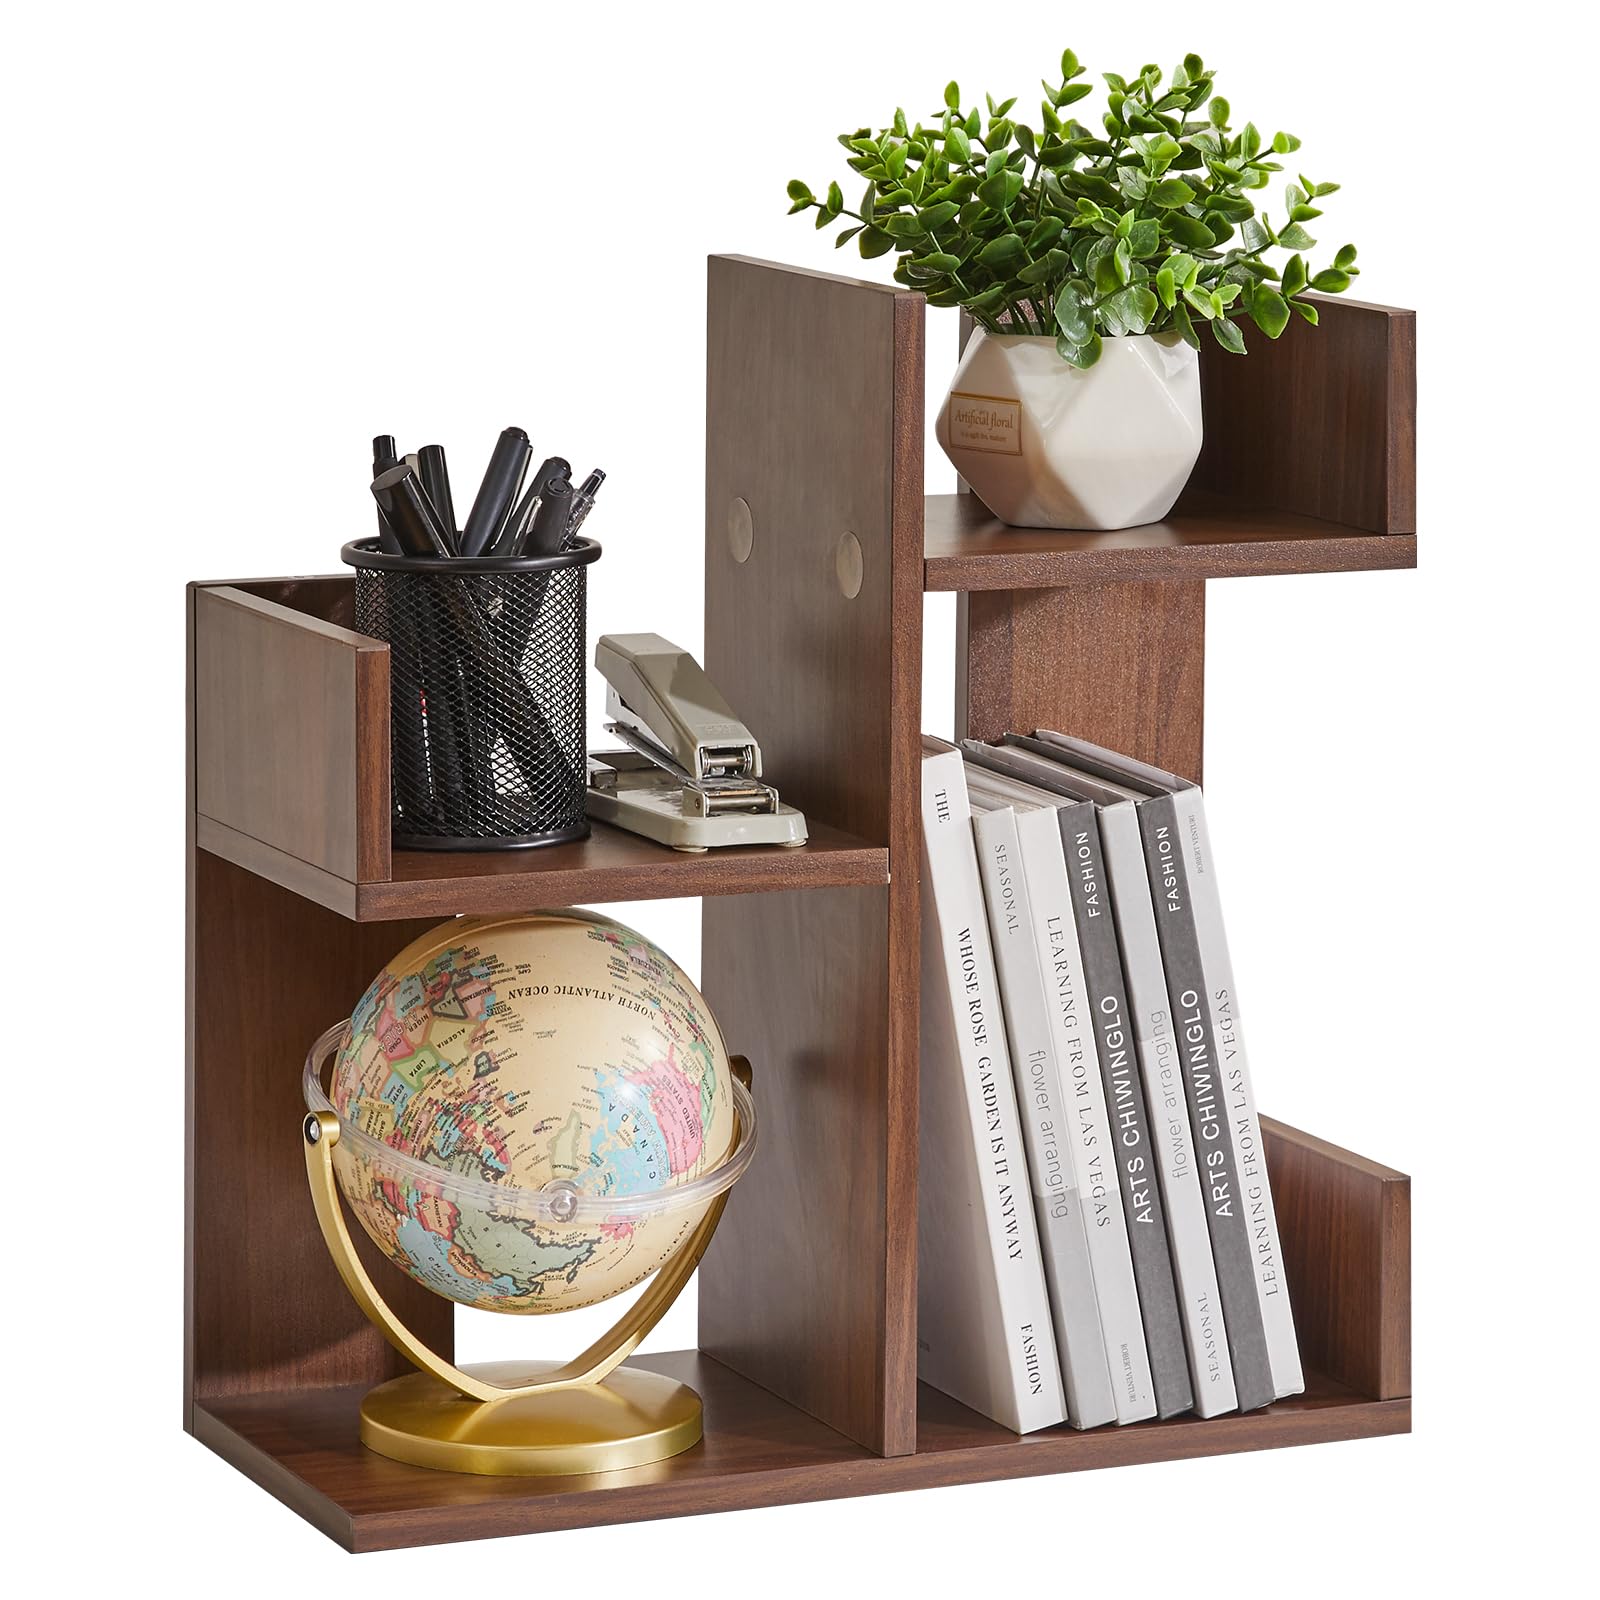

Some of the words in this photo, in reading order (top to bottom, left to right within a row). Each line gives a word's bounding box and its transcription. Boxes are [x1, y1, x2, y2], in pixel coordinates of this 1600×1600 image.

[955, 409, 989, 428] Artificial
[988, 411, 1013, 430] floral
[933, 788, 952, 824] THE
[1075, 831, 1100, 918] FASHION
[1156, 826, 1181, 912] FASHION
[994, 843, 1022, 935] SEASONAL
[629, 955, 662, 977] VENEZUELA
[956, 927, 982, 994] WHOSE
[400, 994, 421, 1013] NIGERIA
[460, 986, 492, 1003] MAURITANIA
[508, 986, 549, 999] OCEAN
[553, 984, 615, 1001] ATLANTIC
[657, 991, 681, 1011] CARIBBEAN
[407, 1014, 429, 1032] NIGER
[618, 997, 656, 1020] NORTH
[969, 993, 989, 1047] ROSE
[436, 1028, 466, 1049] ALGERIA
[471, 1029, 495, 1044] MOROCCO
[1214, 989, 1238, 1063] VEGAS
[388, 1037, 402, 1053] CHAD
[492, 1052, 518, 1066] PORTUGAL
[1150, 1009, 1178, 1109] arranging
[409, 1059, 426, 1077] LIBYA
[1046, 916, 1079, 1029] LEARNING
[1066, 1036, 1090, 1099] FROM
[1078, 1106, 1098, 1149] LAS
[1088, 1155, 1111, 1228] VEGAS
[1100, 995, 1141, 1148] CHIWINGLO
[1180, 989, 1221, 1141] CHIWINGLO
[390, 1084, 404, 1105] EGYPT
[430, 1079, 441, 1090] MALTA
[477, 1078, 499, 1092] FRANCE
[509, 1090, 531, 1102] IRELAND
[662, 1074, 683, 1105] STATES
[977, 1055, 1003, 1131] GARDEN
[1228, 1070, 1249, 1116] LAS
[411, 1120, 422, 1143] TURKEY
[533, 1126, 552, 1135] ICELAND
[682, 1107, 695, 1139] UNITED
[1028, 1048, 1051, 1112] flower
[1040, 1119, 1069, 1220] arranging
[608, 1103, 656, 1179] CANADA
[989, 1134, 1006, 1155] IS
[1171, 1116, 1190, 1180] flower
[1236, 1119, 1261, 1177] FROM
[552, 1164, 579, 1172] GREENLAND
[994, 1158, 1011, 1177] IT
[1128, 1156, 1154, 1224] ARTS
[1206, 1150, 1233, 1217] ARTS
[376, 1207, 390, 1237] INDIA
[998, 1183, 1023, 1262] ANYWAY
[1249, 1186, 1278, 1296] LEARNING
[428, 1256, 459, 1284] CHINA
[451, 1252, 477, 1276] MONGOLIA
[1197, 1292, 1220, 1383] SEASONAL
[1020, 1323, 1043, 1395] FASHION
